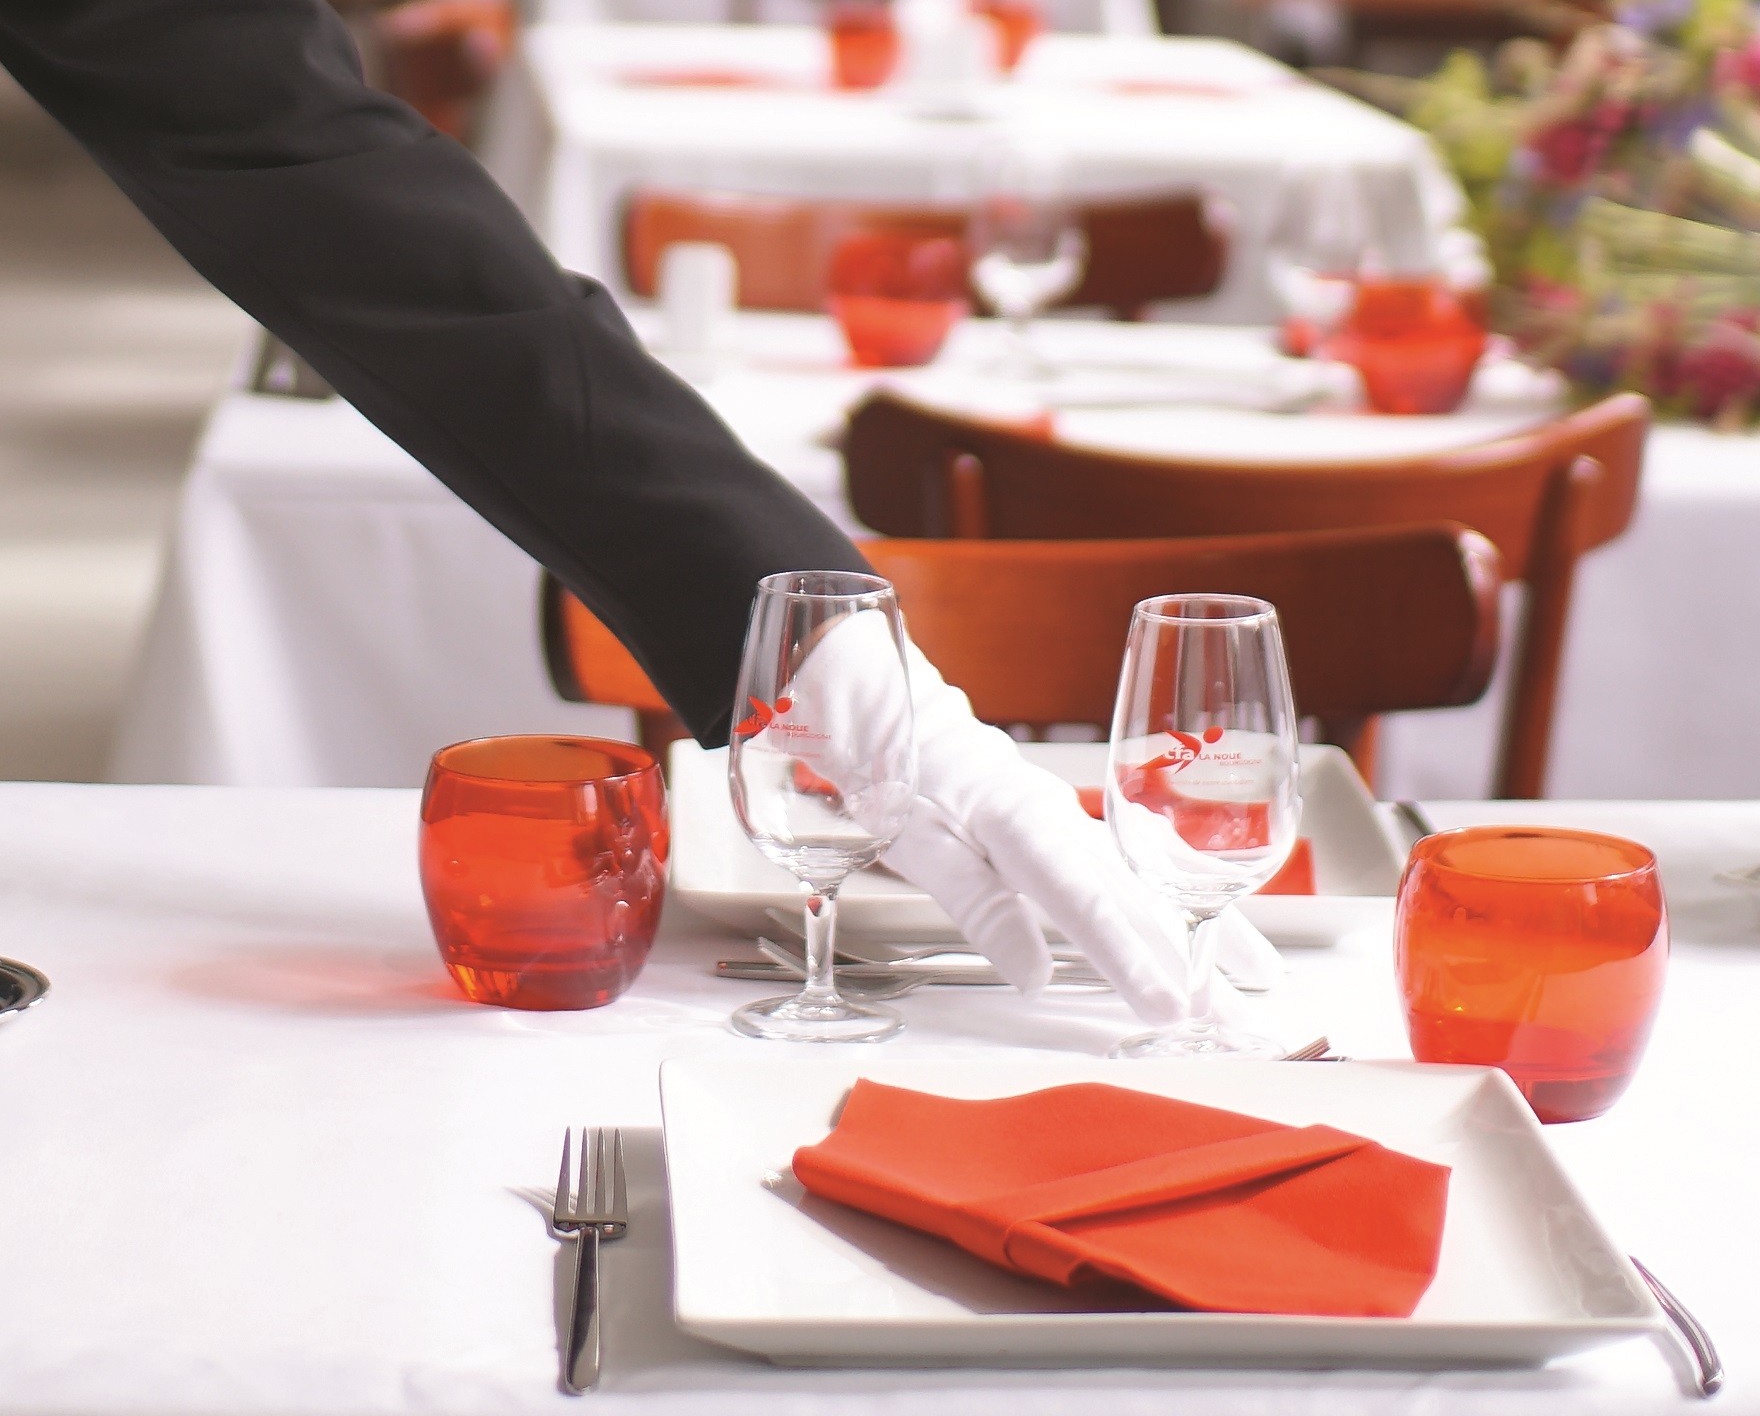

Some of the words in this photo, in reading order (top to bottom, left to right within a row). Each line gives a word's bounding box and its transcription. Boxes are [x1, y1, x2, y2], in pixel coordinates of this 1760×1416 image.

[783, 723, 809, 732] NOUE
[1163, 742, 1196, 760] cfa
[1214, 752, 1242, 760] NOUE
